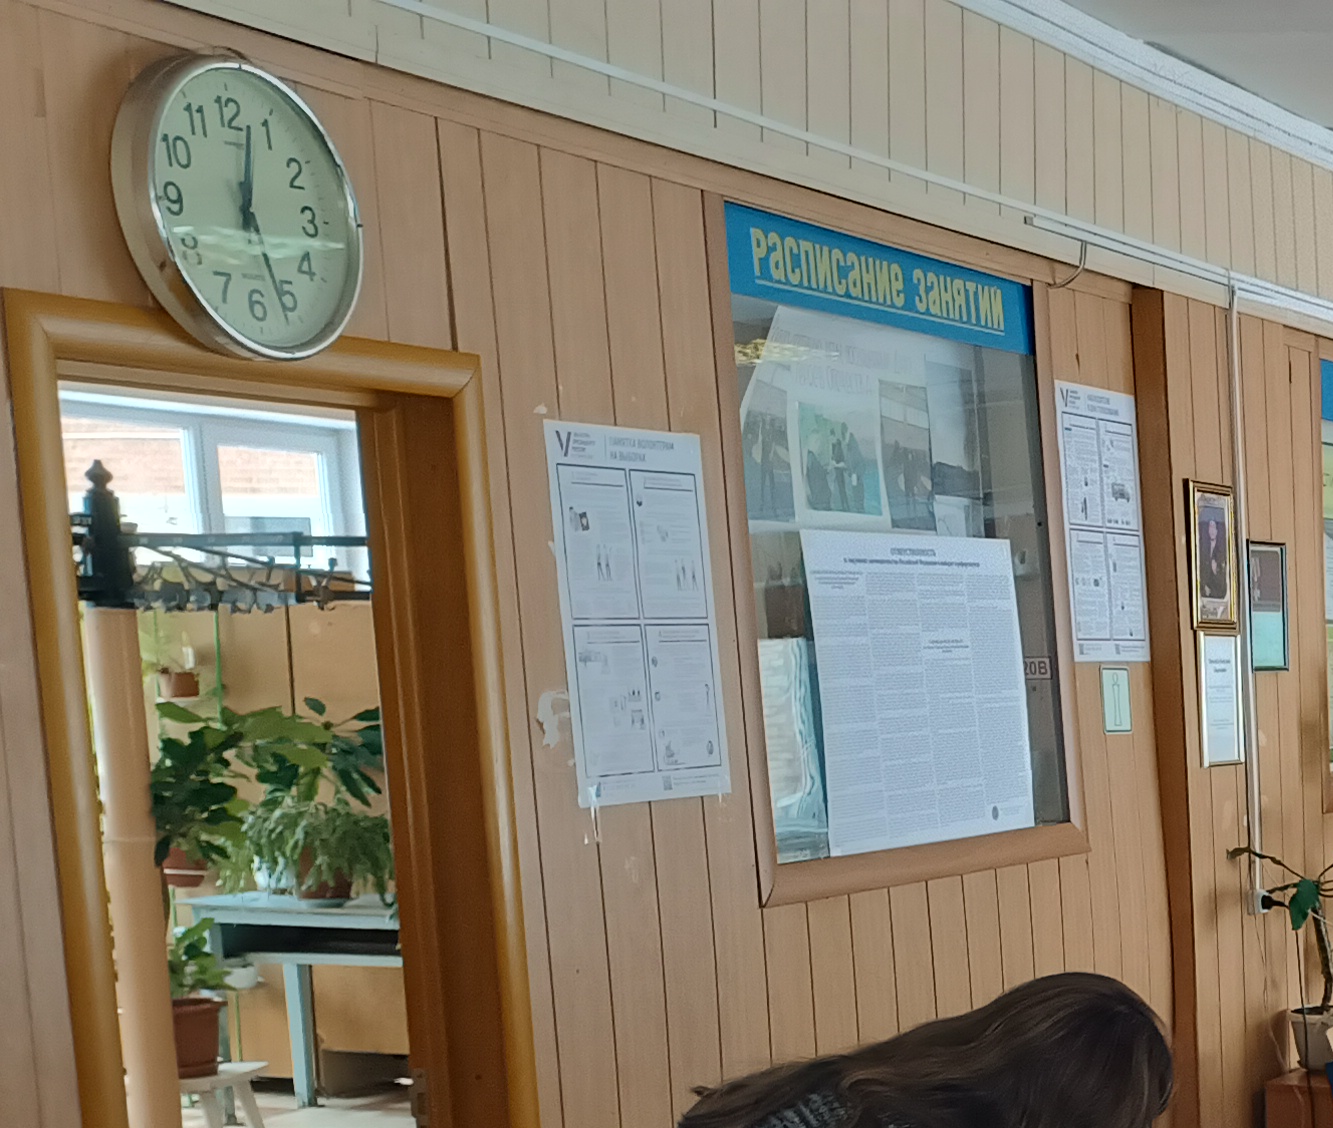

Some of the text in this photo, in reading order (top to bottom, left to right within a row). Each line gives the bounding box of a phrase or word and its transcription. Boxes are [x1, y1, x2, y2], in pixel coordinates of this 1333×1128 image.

[183, 102, 207, 138] 11
[214, 95, 244, 131] 12
[160, 133, 192, 169] 10
[260, 118, 273, 150] 1
[285, 157, 306, 190] 2
[163, 180, 184, 216] 9
[300, 205, 319, 238] 3
[297, 251, 317, 282] 4
[750, 227, 906, 308] Расписание
[212, 270, 232, 304] 7
[278, 279, 298, 313] 5
[248, 288, 268, 322] 6
